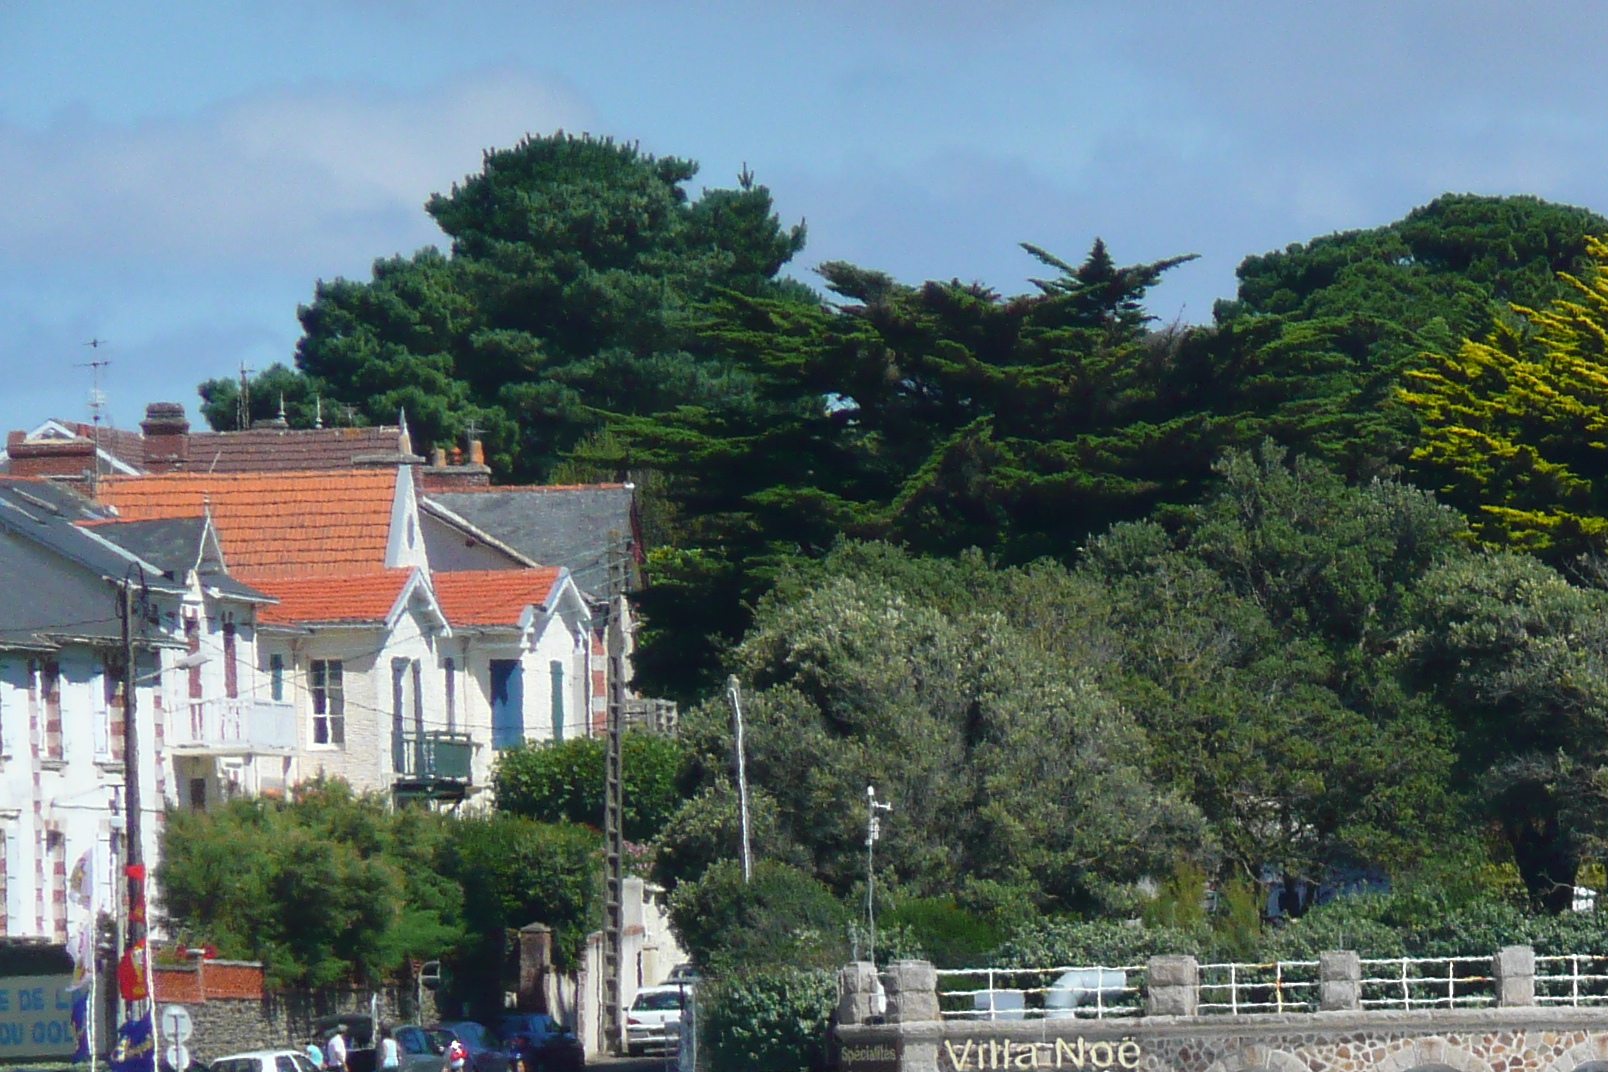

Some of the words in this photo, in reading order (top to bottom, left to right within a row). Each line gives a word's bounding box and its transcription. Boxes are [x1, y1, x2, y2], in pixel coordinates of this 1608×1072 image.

[19, 987, 45, 1011] DE
[944, 1038, 1038, 1072] Villa
[1055, 1036, 1141, 1069] Noë
